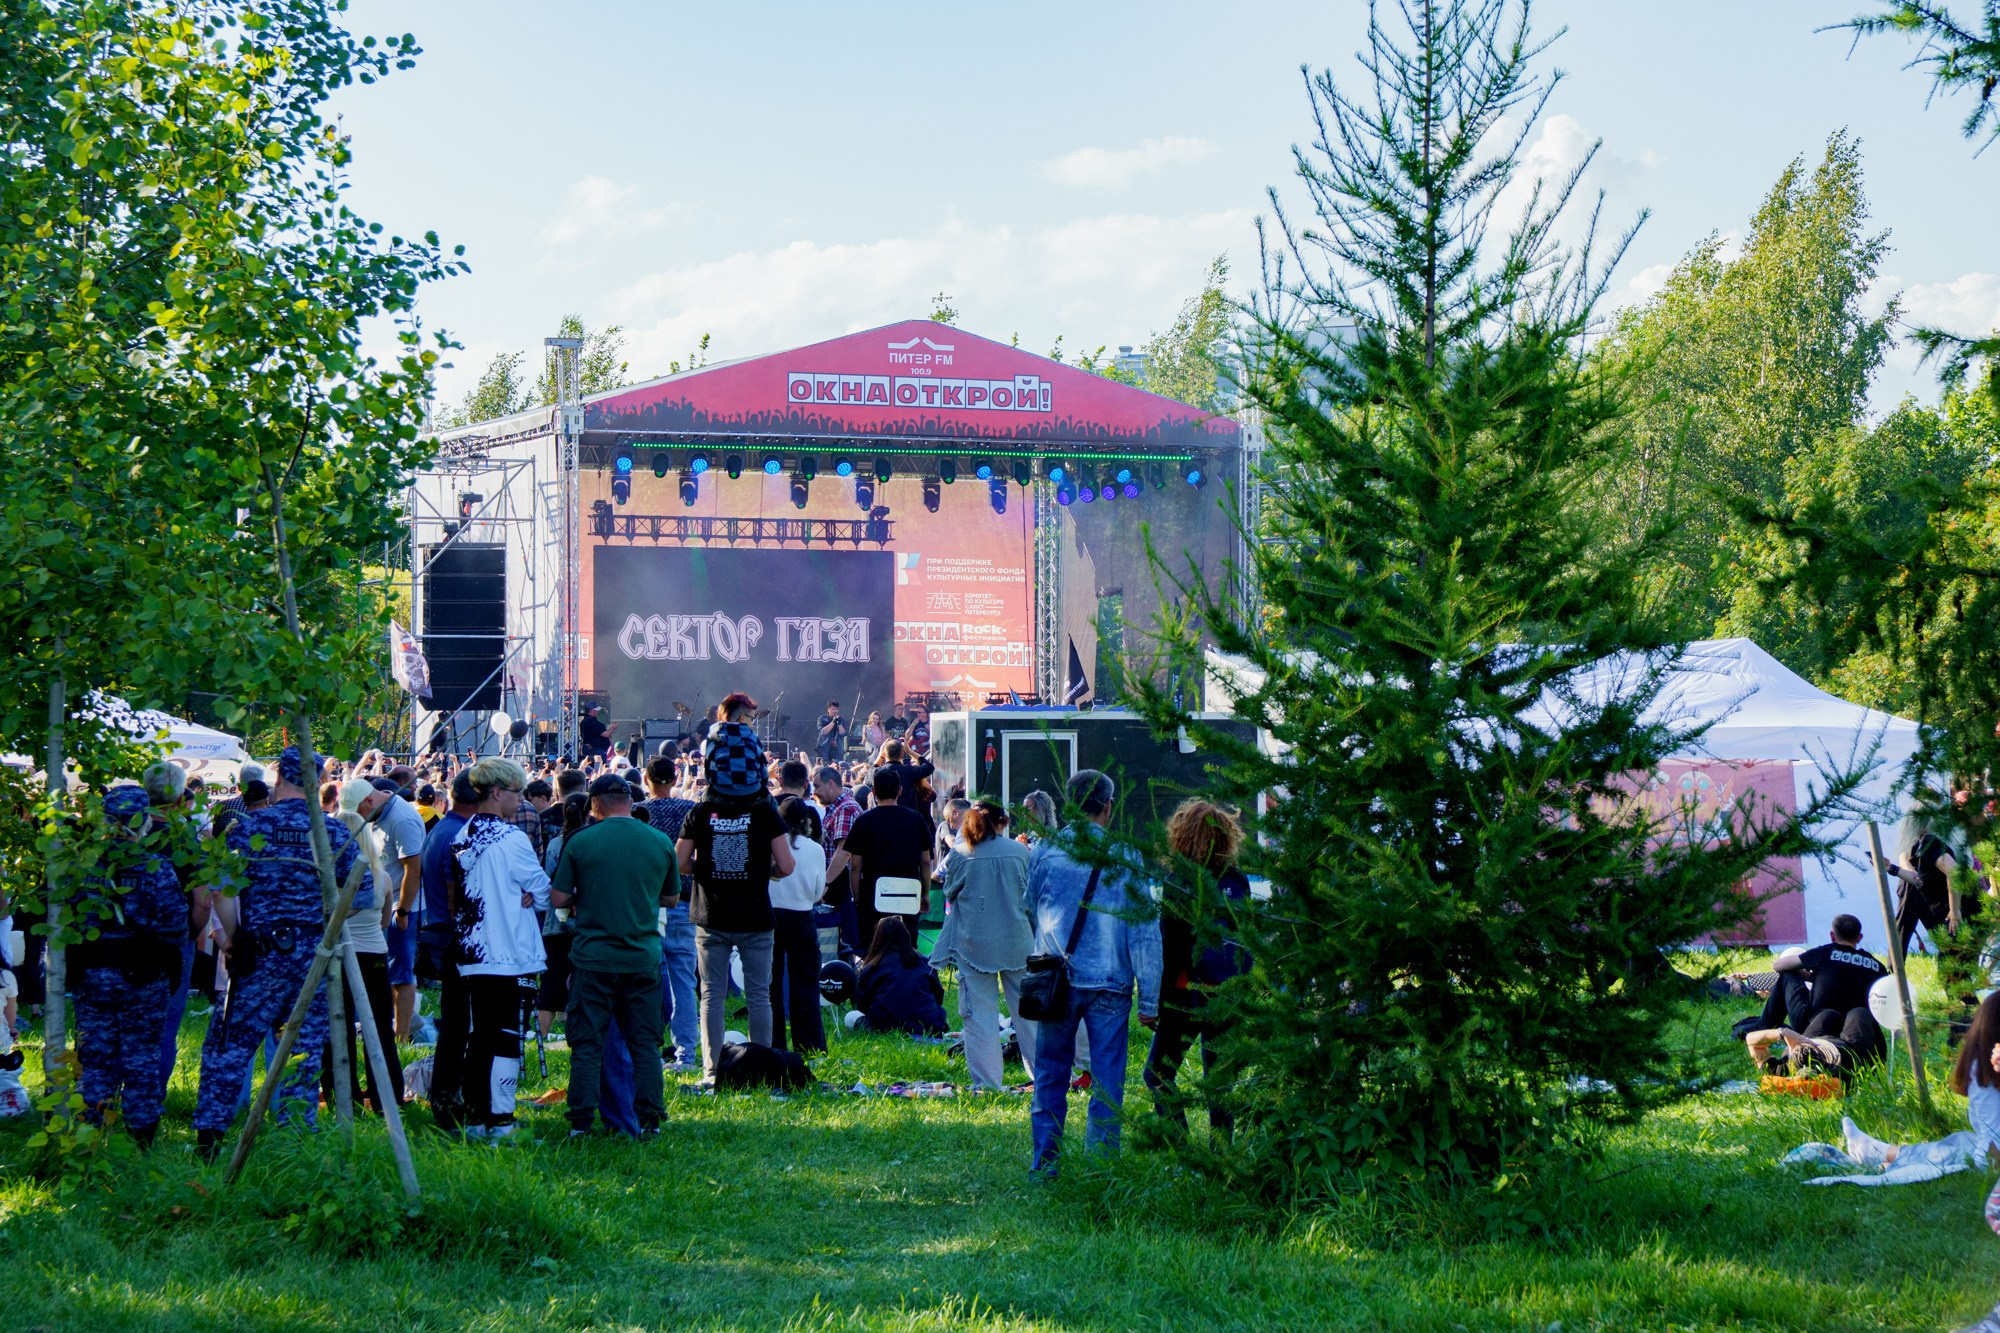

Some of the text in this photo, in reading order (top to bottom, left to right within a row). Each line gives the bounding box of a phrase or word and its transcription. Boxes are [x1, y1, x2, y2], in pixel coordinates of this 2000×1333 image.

[889, 352, 953, 365] ПИТЕР FM
[911, 367, 932, 376] 100.9
[789, 378, 1050, 409] ОКНА ОТКРОЙ!
[927, 566, 1025, 575] ПРЕЗИДЕНТСКОГО ФОНДА
[617, 610, 764, 663] СЕКТОР
[774, 616, 870, 663] ГАЗА
[894, 625, 960, 641] ОКНА
[927, 644, 1032, 667] ОТКРОЙ!
[277, 830, 333, 844] РОСГВЯ
